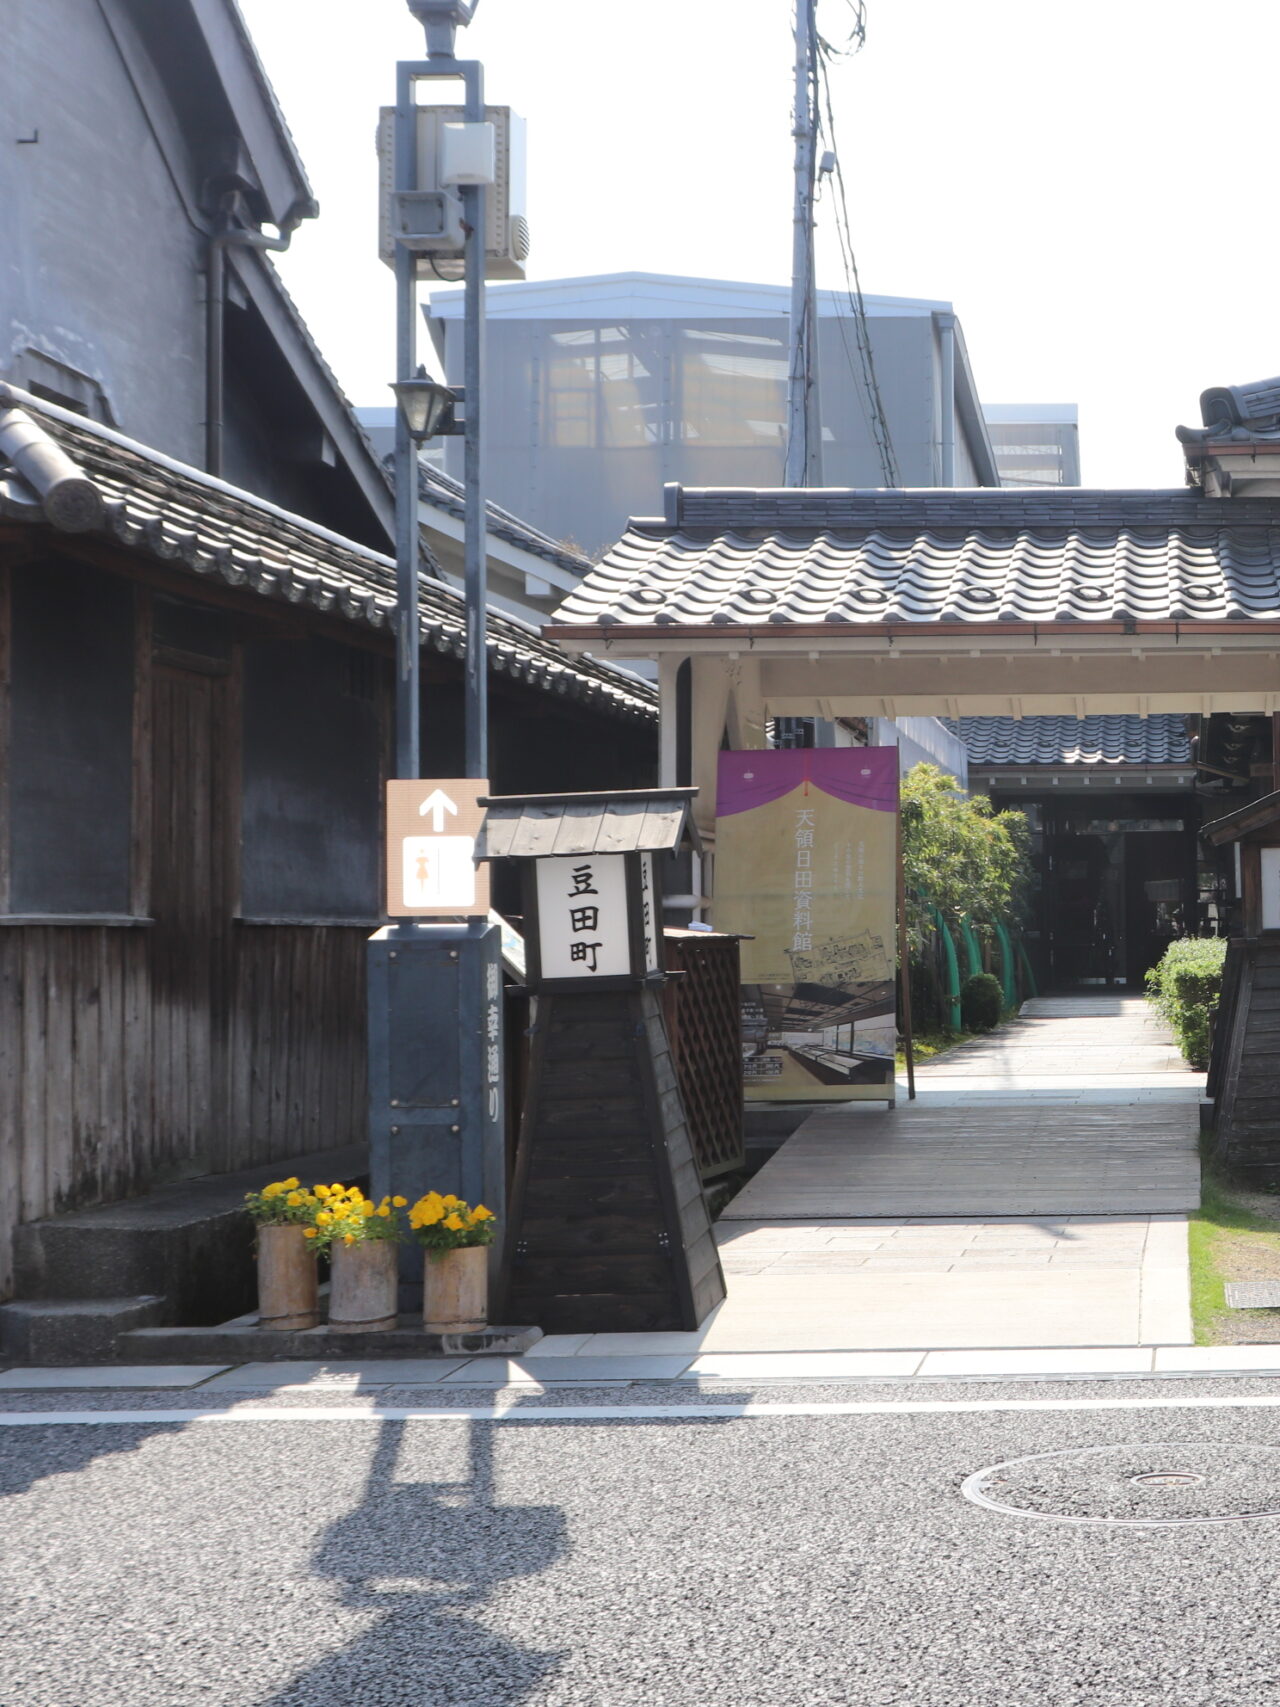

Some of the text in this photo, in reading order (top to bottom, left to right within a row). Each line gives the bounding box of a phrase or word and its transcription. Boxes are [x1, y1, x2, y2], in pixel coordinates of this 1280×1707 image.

[567, 864, 603, 972] 豆田町
[792, 808, 815, 951] 天領日田資料館
